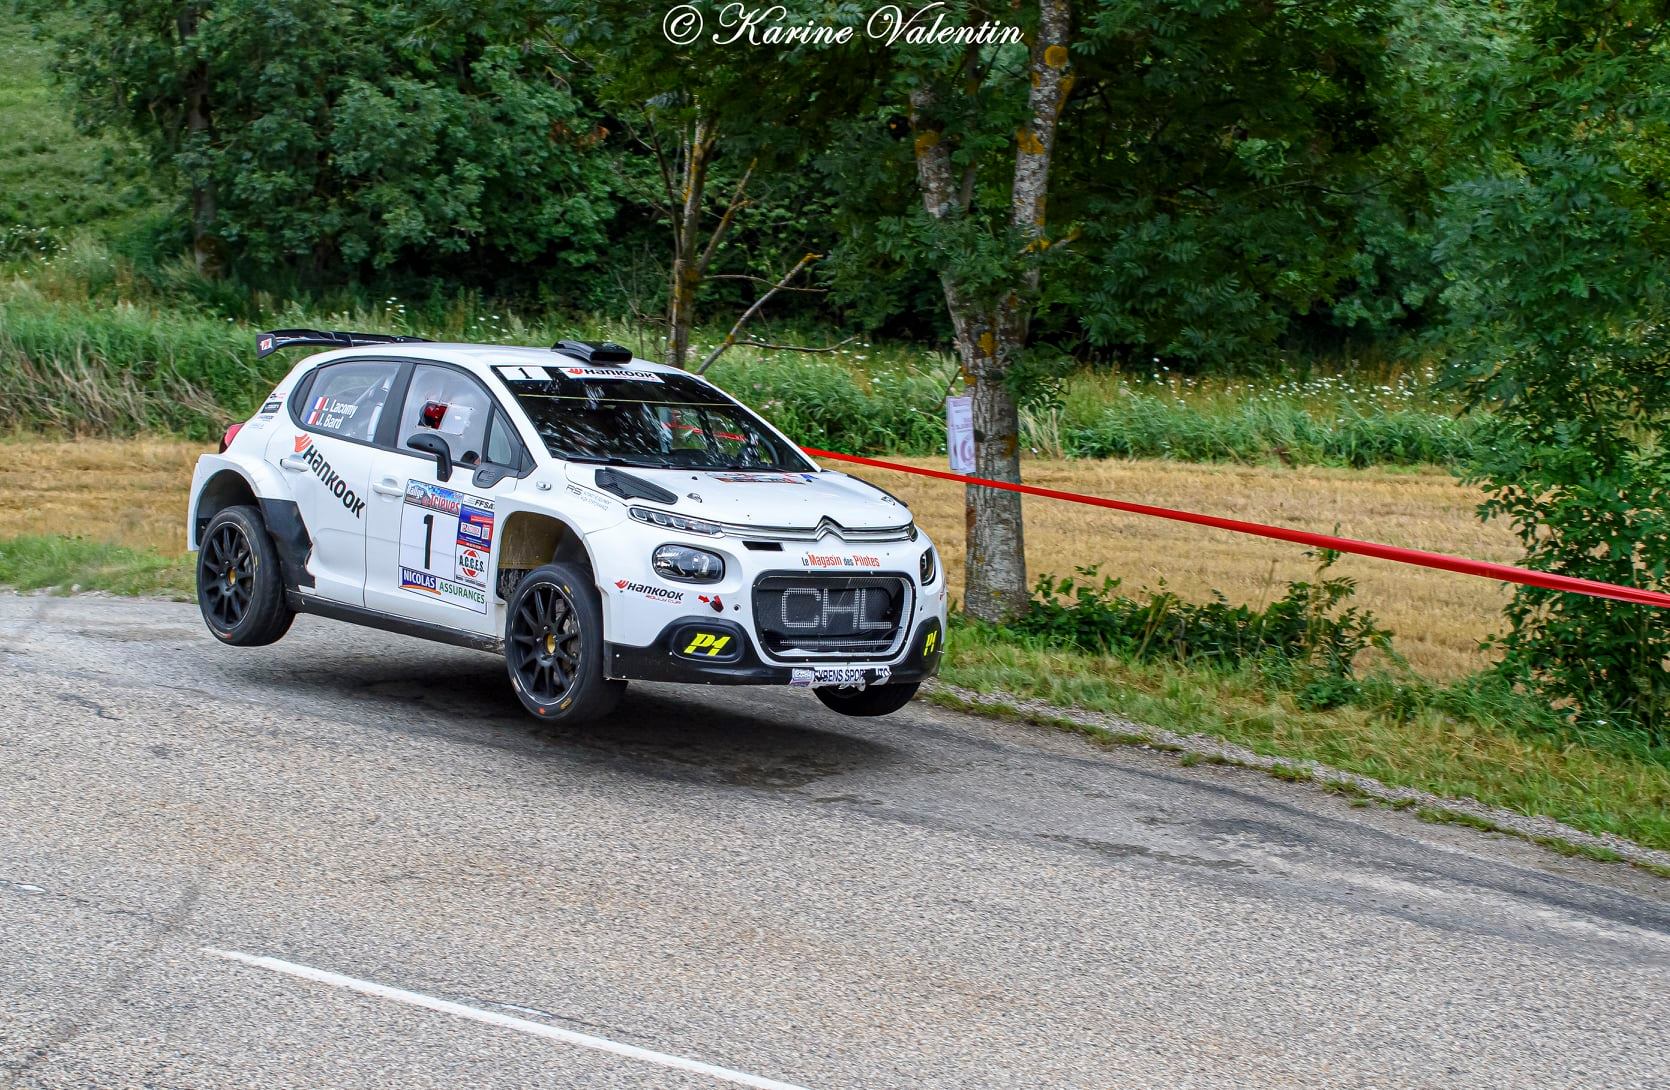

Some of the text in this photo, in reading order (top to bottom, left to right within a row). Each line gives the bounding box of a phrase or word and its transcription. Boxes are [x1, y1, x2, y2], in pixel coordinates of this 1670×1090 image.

[518, 367, 533, 380] 1
[323, 413, 345, 429] Bard
[474, 499, 494, 510] FFSA
[423, 514, 434, 570] 1
[808, 554, 842, 568] Magasin
[844, 558, 854, 566] des
[853, 555, 881, 567] Pilotes
[403, 570, 436, 587] NICOLAS
[439, 581, 486, 605] ASSURANCES
[781, 587, 892, 628] CHL
